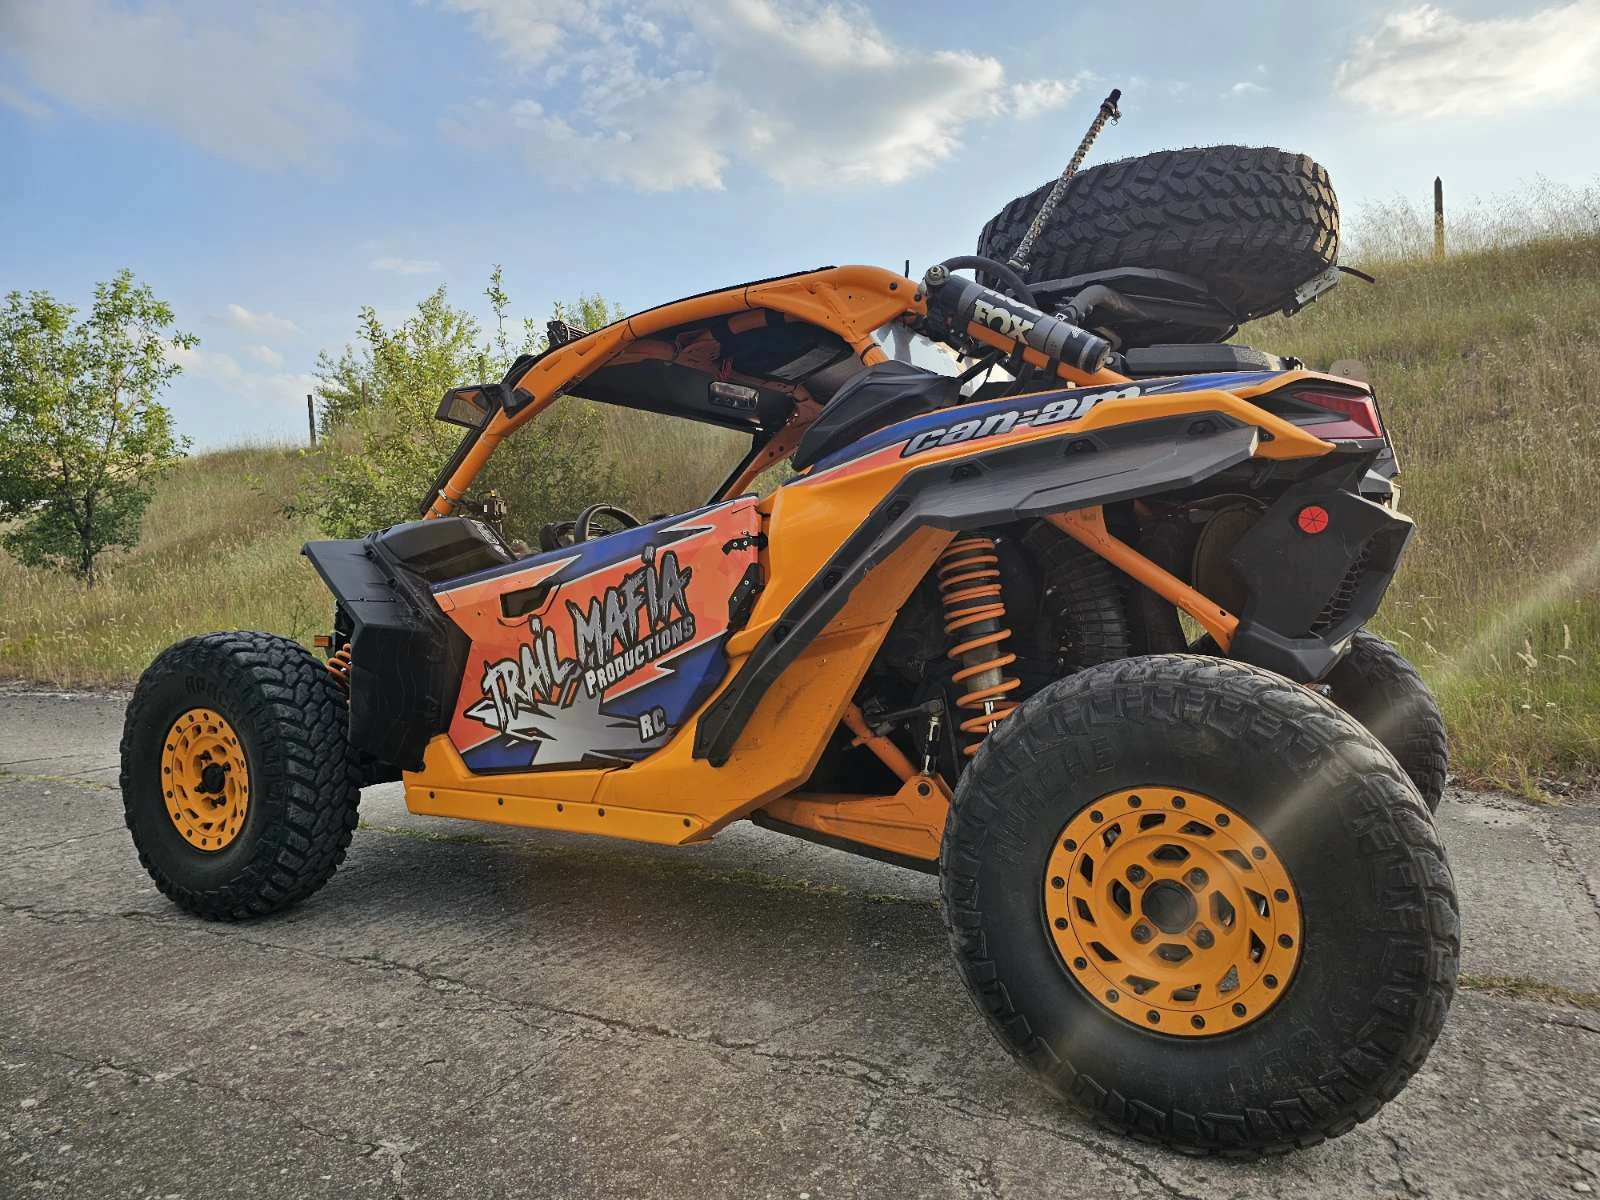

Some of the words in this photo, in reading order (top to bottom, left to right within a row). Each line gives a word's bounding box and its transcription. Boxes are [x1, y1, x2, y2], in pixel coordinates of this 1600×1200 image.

[974, 298, 1035, 345] FOX
[584, 615, 694, 696] PRODUCTIONS
[639, 708, 666, 740] RC
